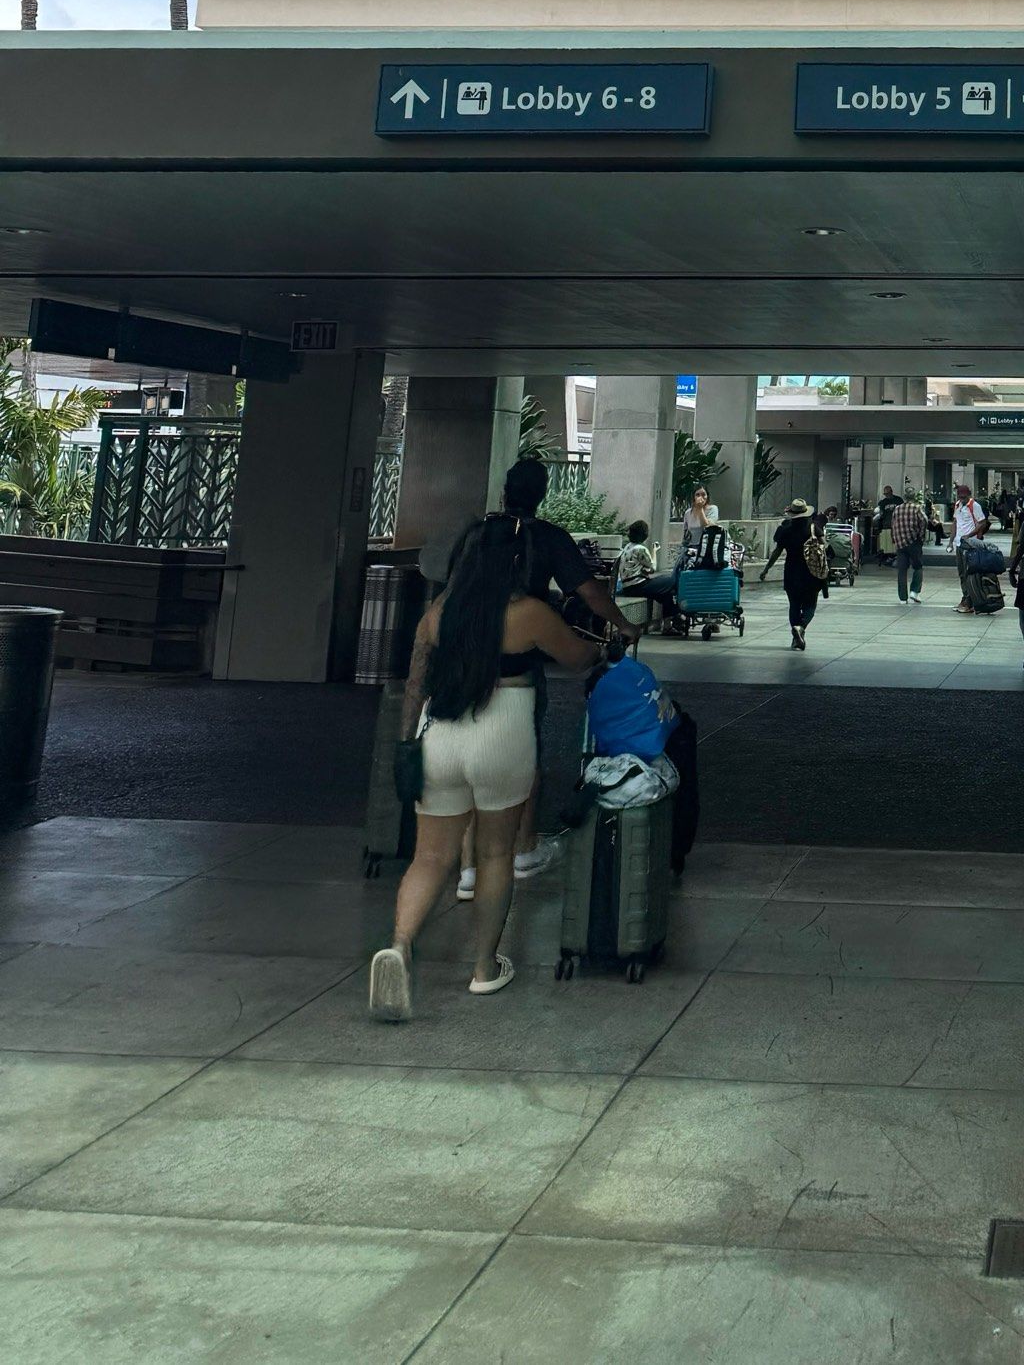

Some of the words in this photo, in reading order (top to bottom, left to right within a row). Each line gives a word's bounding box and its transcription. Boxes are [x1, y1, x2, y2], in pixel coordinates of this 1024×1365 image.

[501, 85, 593, 117] Lobby
[836, 85, 926, 116] Lobby
[935, 86, 951, 110] 5
[997, 417, 1014, 425] Lobby
